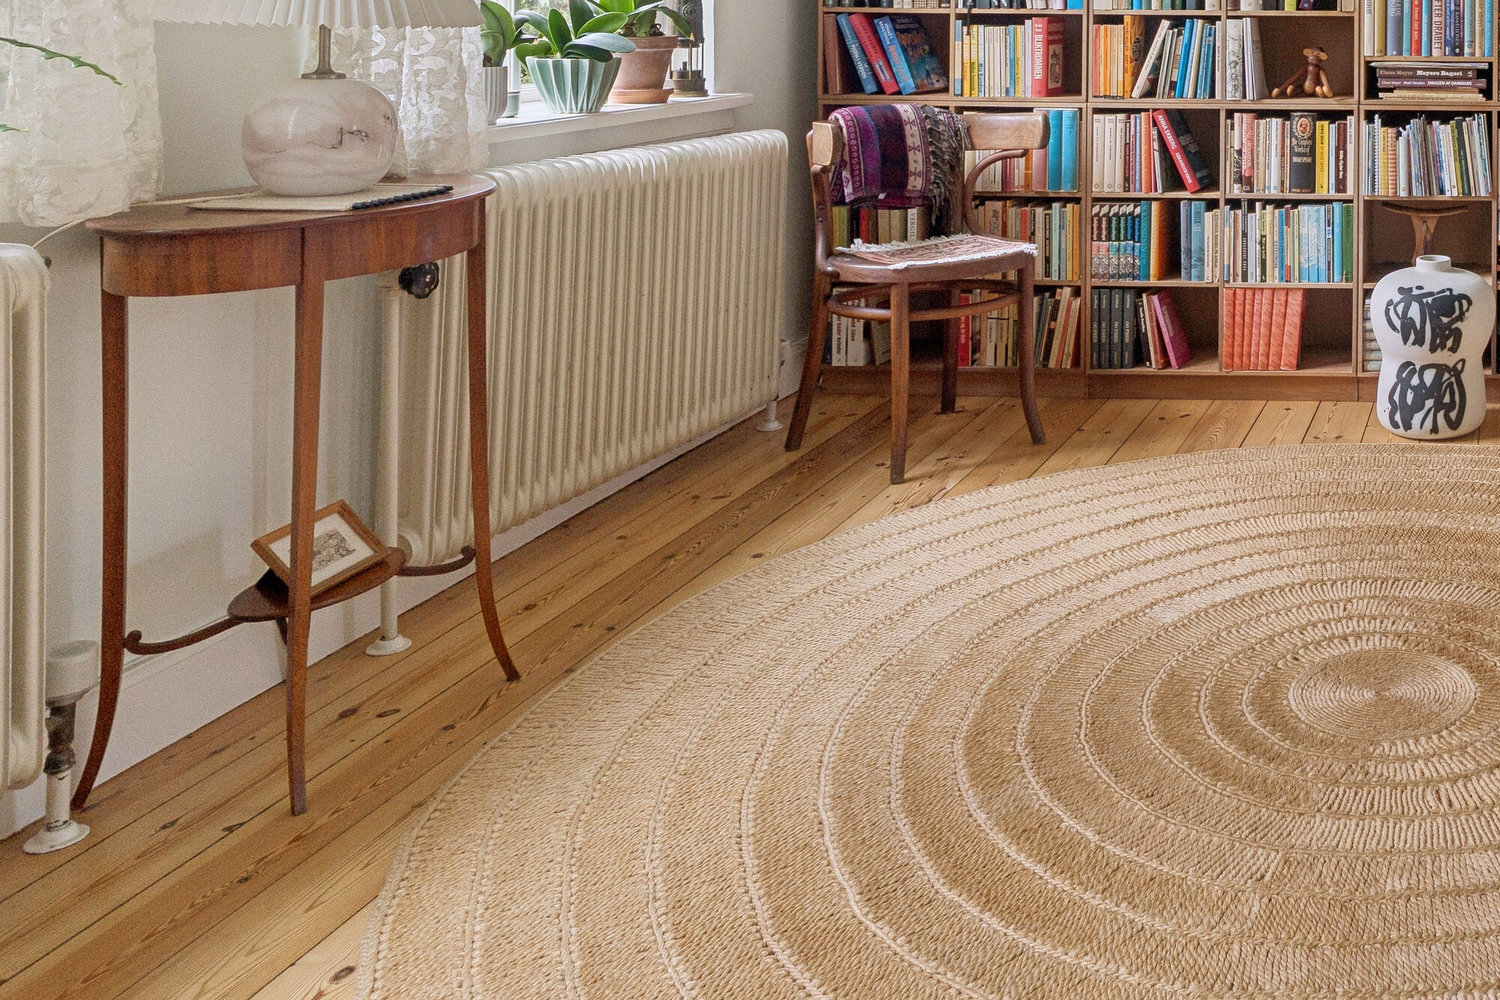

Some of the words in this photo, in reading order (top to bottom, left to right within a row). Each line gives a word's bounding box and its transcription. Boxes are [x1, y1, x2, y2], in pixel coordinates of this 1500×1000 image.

[1433, 20, 1443, 50] DRABET
[1034, 34, 1043, 80] BLIKTROMMEN
[835, 322, 843, 336] hader
[835, 337, 843, 355] kvinder
